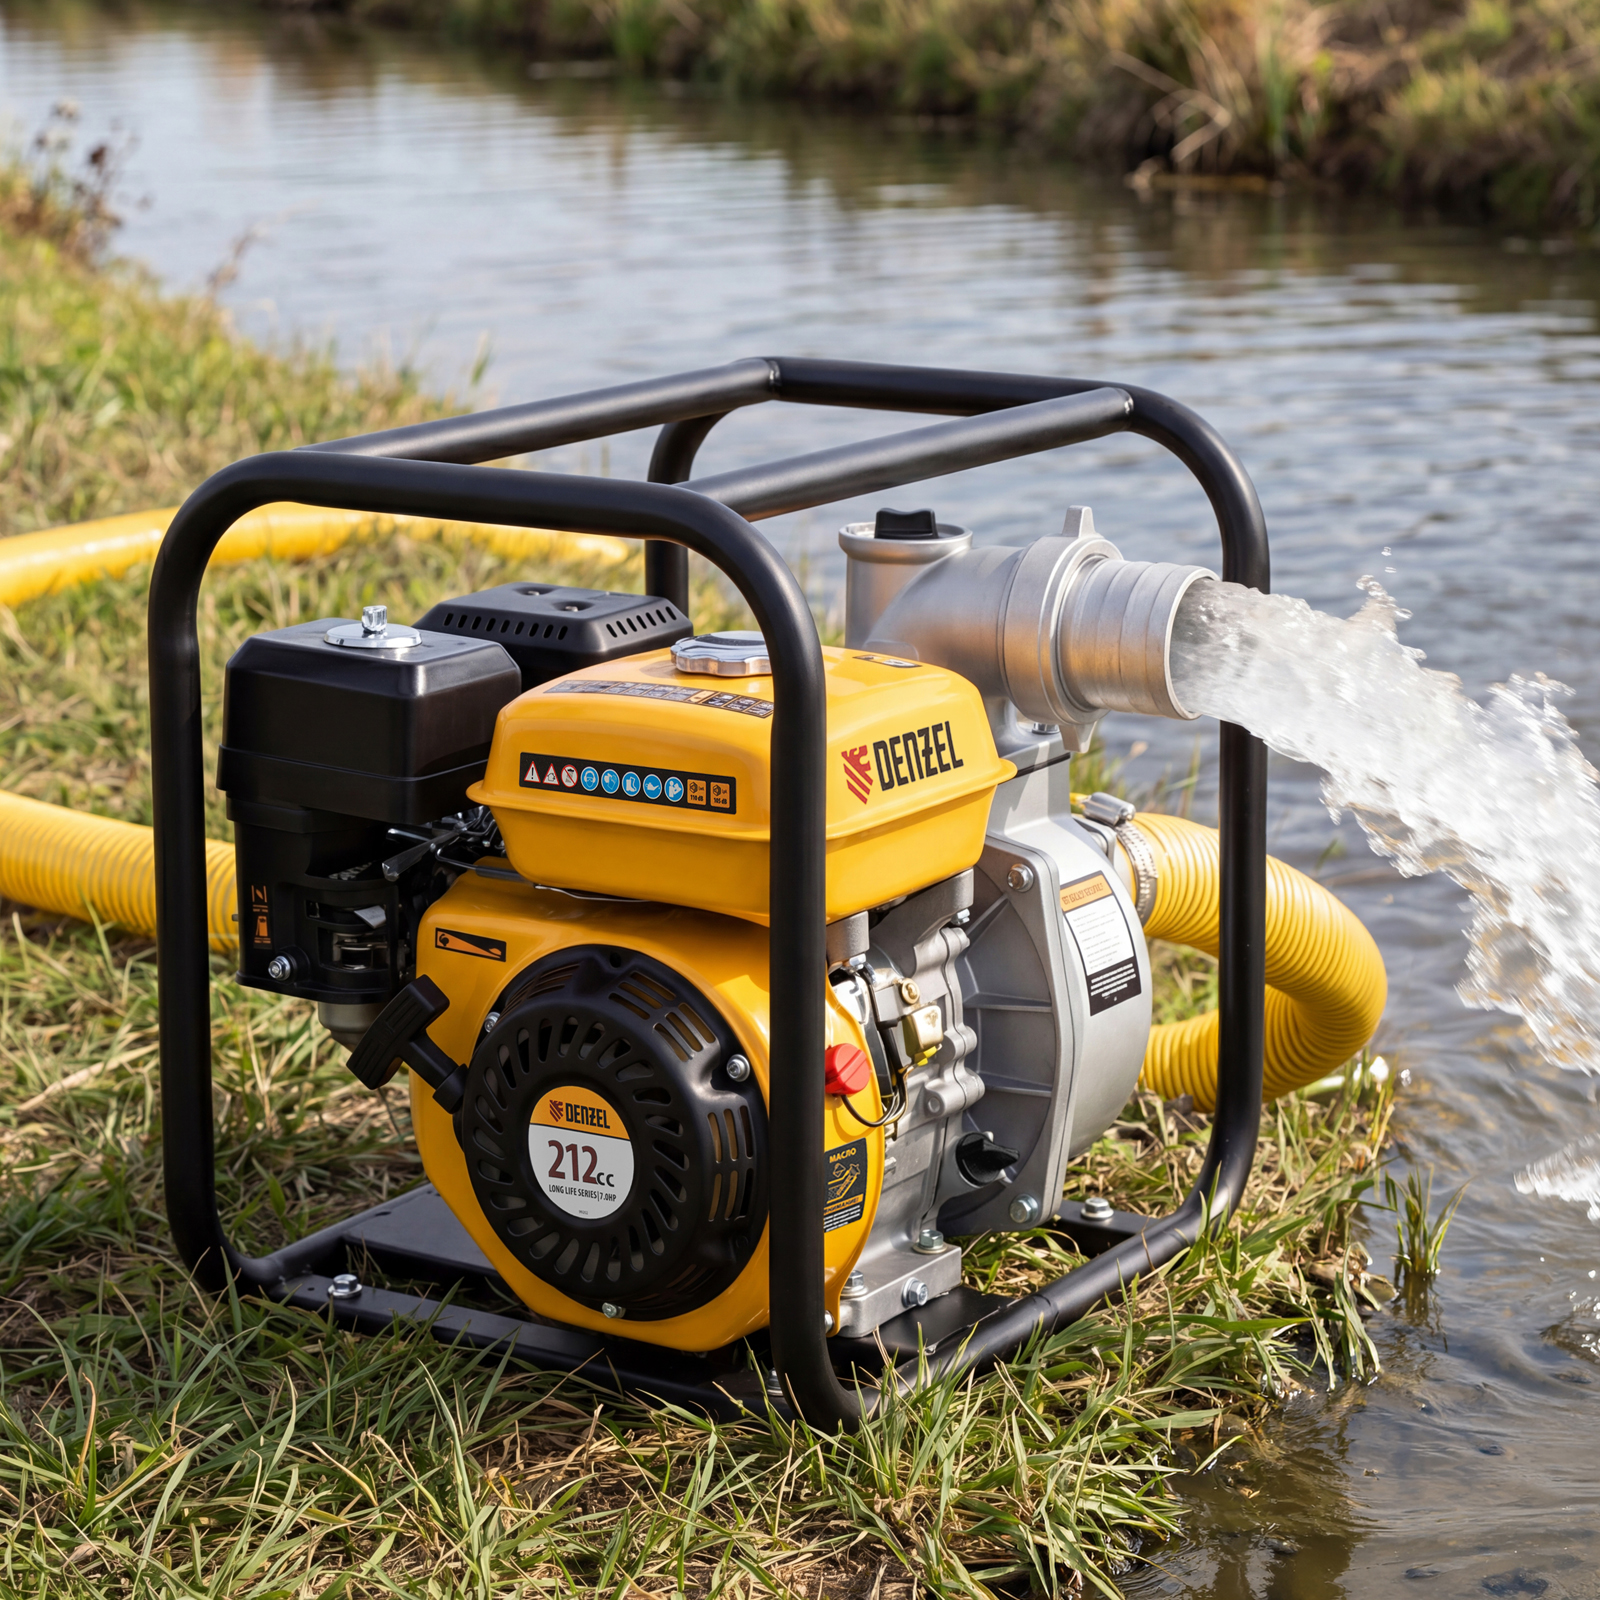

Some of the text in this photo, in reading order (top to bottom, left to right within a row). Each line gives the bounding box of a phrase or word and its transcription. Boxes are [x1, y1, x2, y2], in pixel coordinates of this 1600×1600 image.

[873, 720, 964, 792] DENZEL
[565, 1102, 610, 1129] DENZEL
[829, 1147, 857, 1163] МАСЛО
[549, 1184, 564, 1194] LONG
[565, 1186, 577, 1196] LIFE
